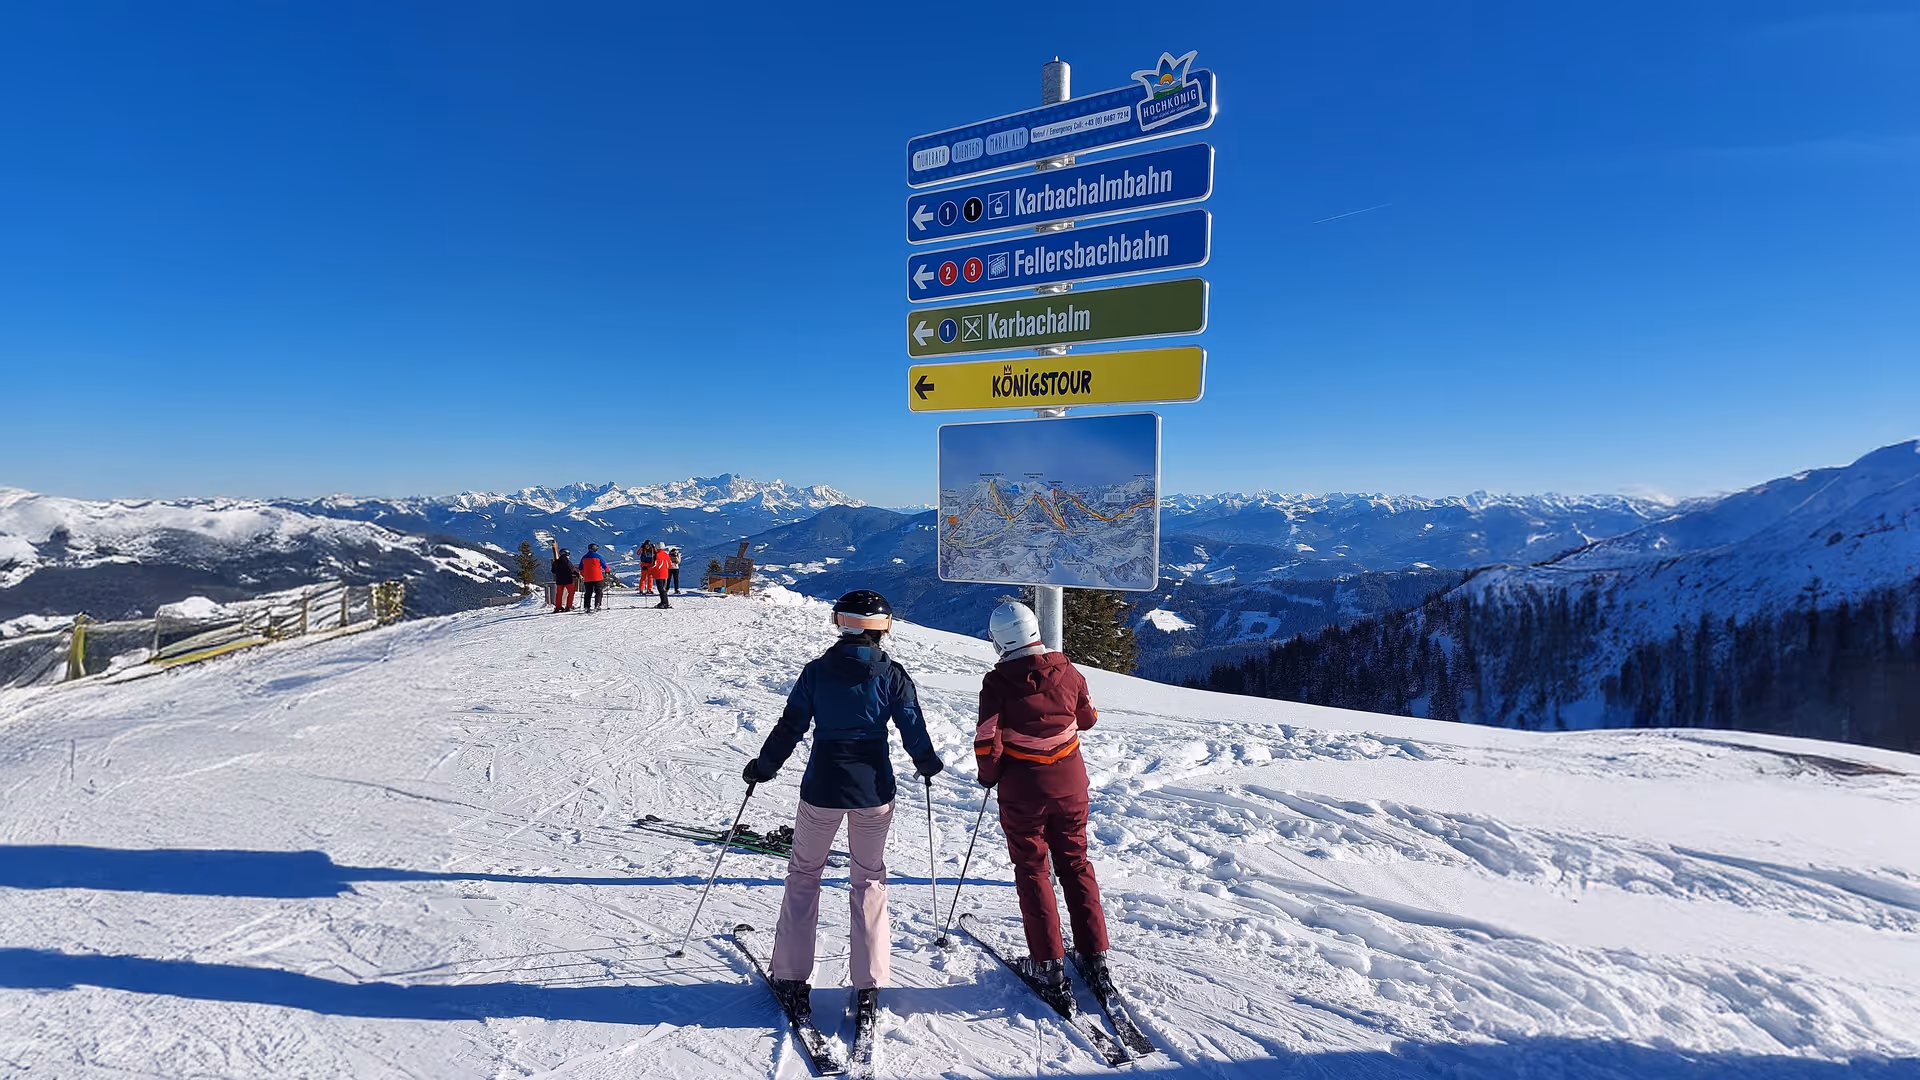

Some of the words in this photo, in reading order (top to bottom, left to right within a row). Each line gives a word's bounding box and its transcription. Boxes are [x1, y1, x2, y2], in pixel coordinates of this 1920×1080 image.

[1143, 89, 1197, 118] HOCHKÖNIG
[1049, 124, 1073, 135] Emergency
[1073, 122, 1083, 130] Call:
[1084, 118, 1094, 127] +43
[955, 141, 980, 160] DIENTEN
[990, 134, 1008, 153] MARIA
[1012, 130, 1024, 148] ALM
[945, 206, 950, 221] 1
[970, 202, 975, 217] 1
[1015, 166, 1172, 216] Karbachalmbahn
[945, 266, 951, 281] 2
[970, 263, 976, 277] 3
[1014, 230, 1169, 277] Fellersbachbahn
[945, 323, 950, 338] 1
[987, 305, 1091, 340] Karbachalm
